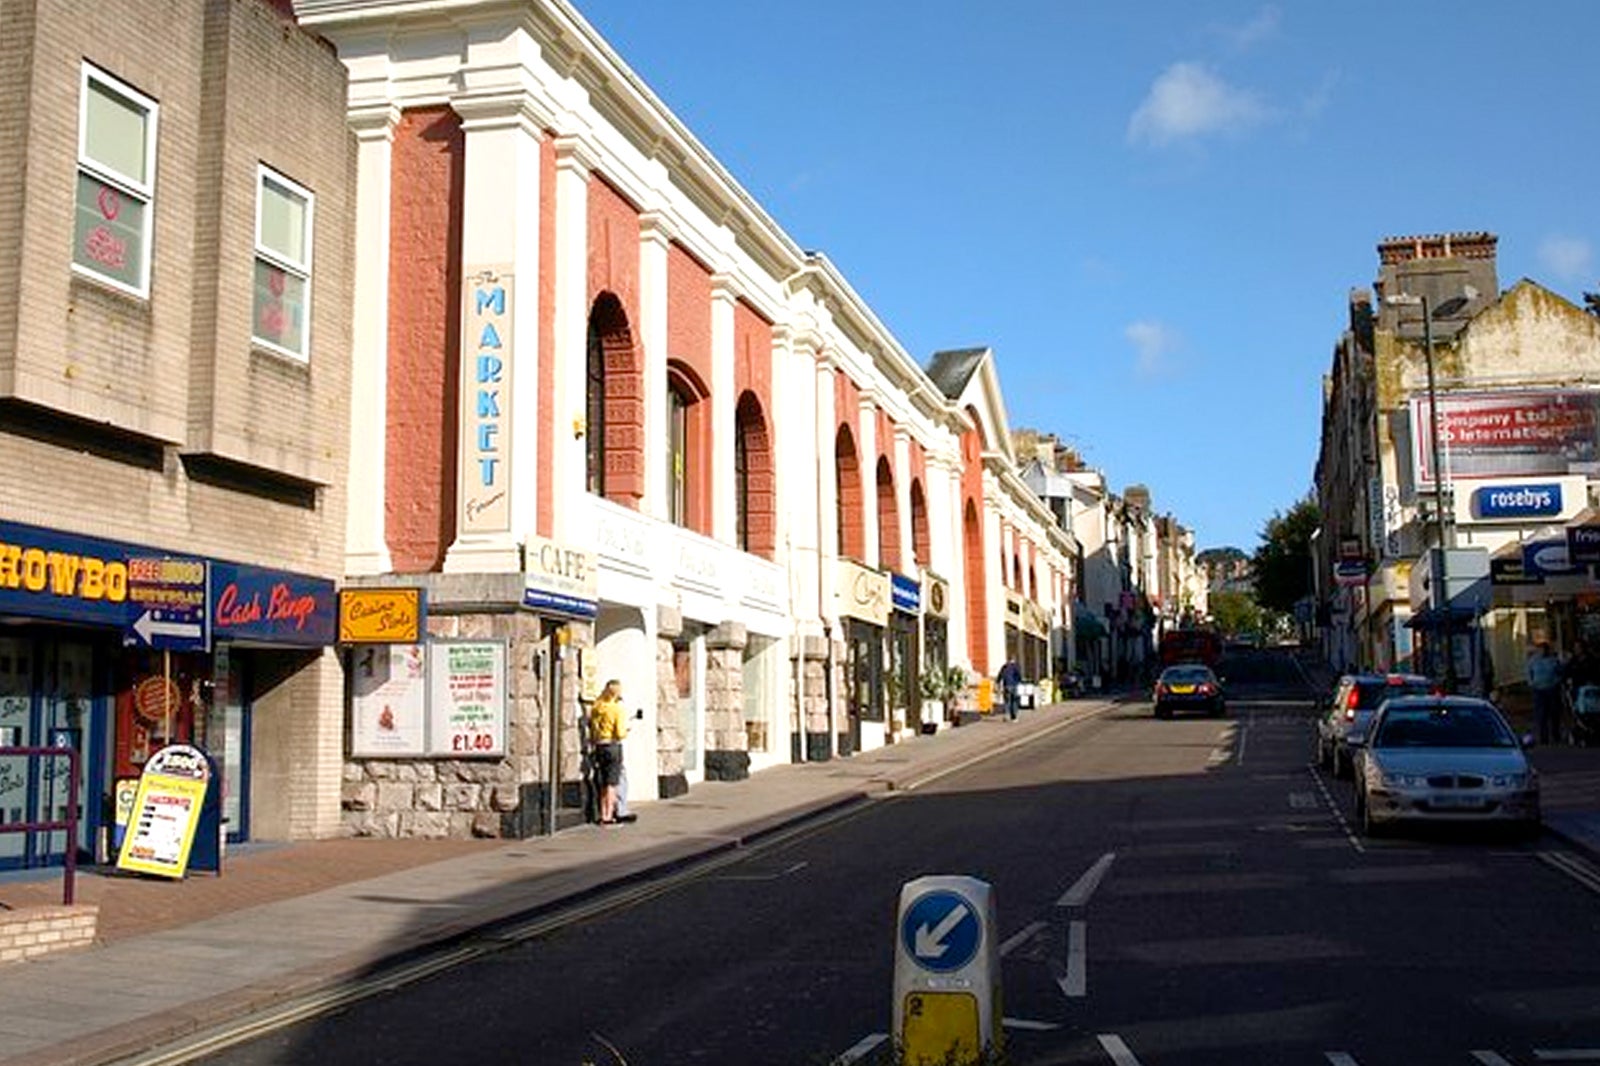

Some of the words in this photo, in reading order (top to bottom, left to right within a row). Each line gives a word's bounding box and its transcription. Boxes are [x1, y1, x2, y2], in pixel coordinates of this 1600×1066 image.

[475, 287, 506, 487] MARKET
[1490, 488, 1551, 510] rosebys
[0, 543, 127, 602] HOWBO
[216, 583, 260, 627] Cash
[266, 583, 315, 630] Bingo
[452, 734, 494, 752] £1.40
